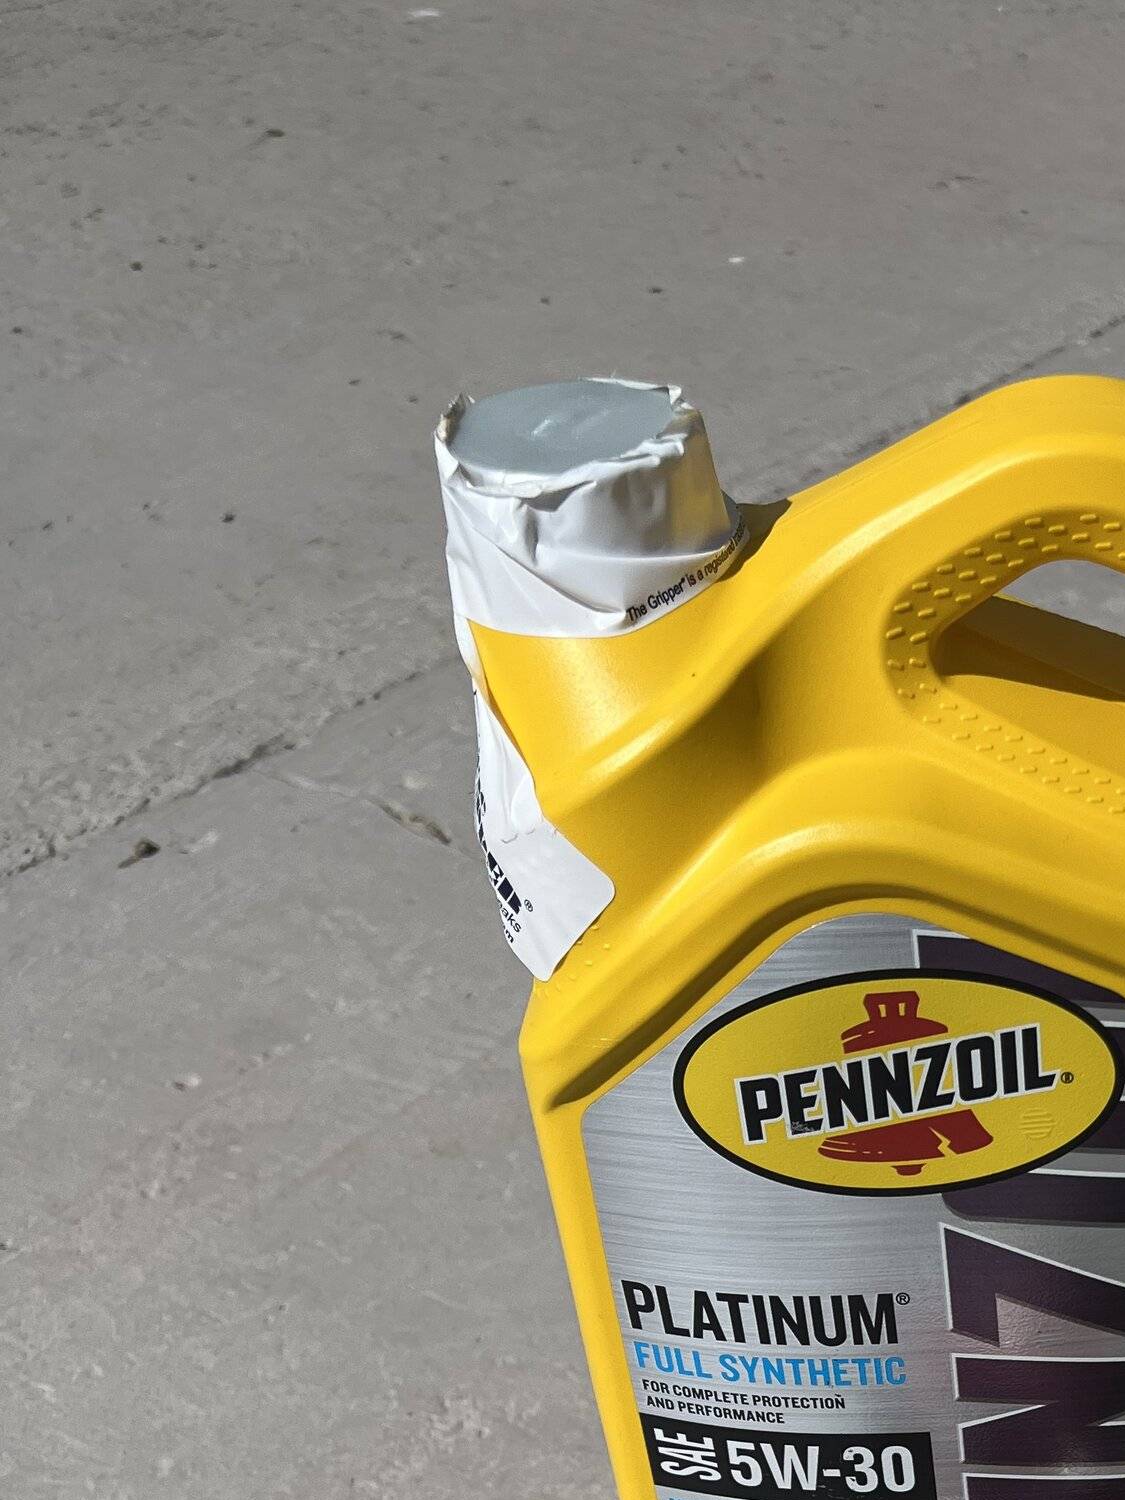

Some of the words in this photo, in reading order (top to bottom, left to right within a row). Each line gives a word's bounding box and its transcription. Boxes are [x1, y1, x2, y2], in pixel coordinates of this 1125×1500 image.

[626, 603, 647, 621] The
[685, 573, 697, 587] is
[697, 569, 704, 581] a
[632, 1340, 714, 1380] FULL
[720, 1353, 908, 1387] SYNTHETIC
[641, 1379, 671, 1395] FOR
[673, 1384, 750, 1406] COMPLETE
[752, 1395, 846, 1410] PROTECTION
[646, 1396, 675, 1411] AND
[678, 1402, 786, 1425] PERFORMANCE
[653, 1427, 722, 1482] SAE
[726, 1439, 916, 1493] 5W-30
